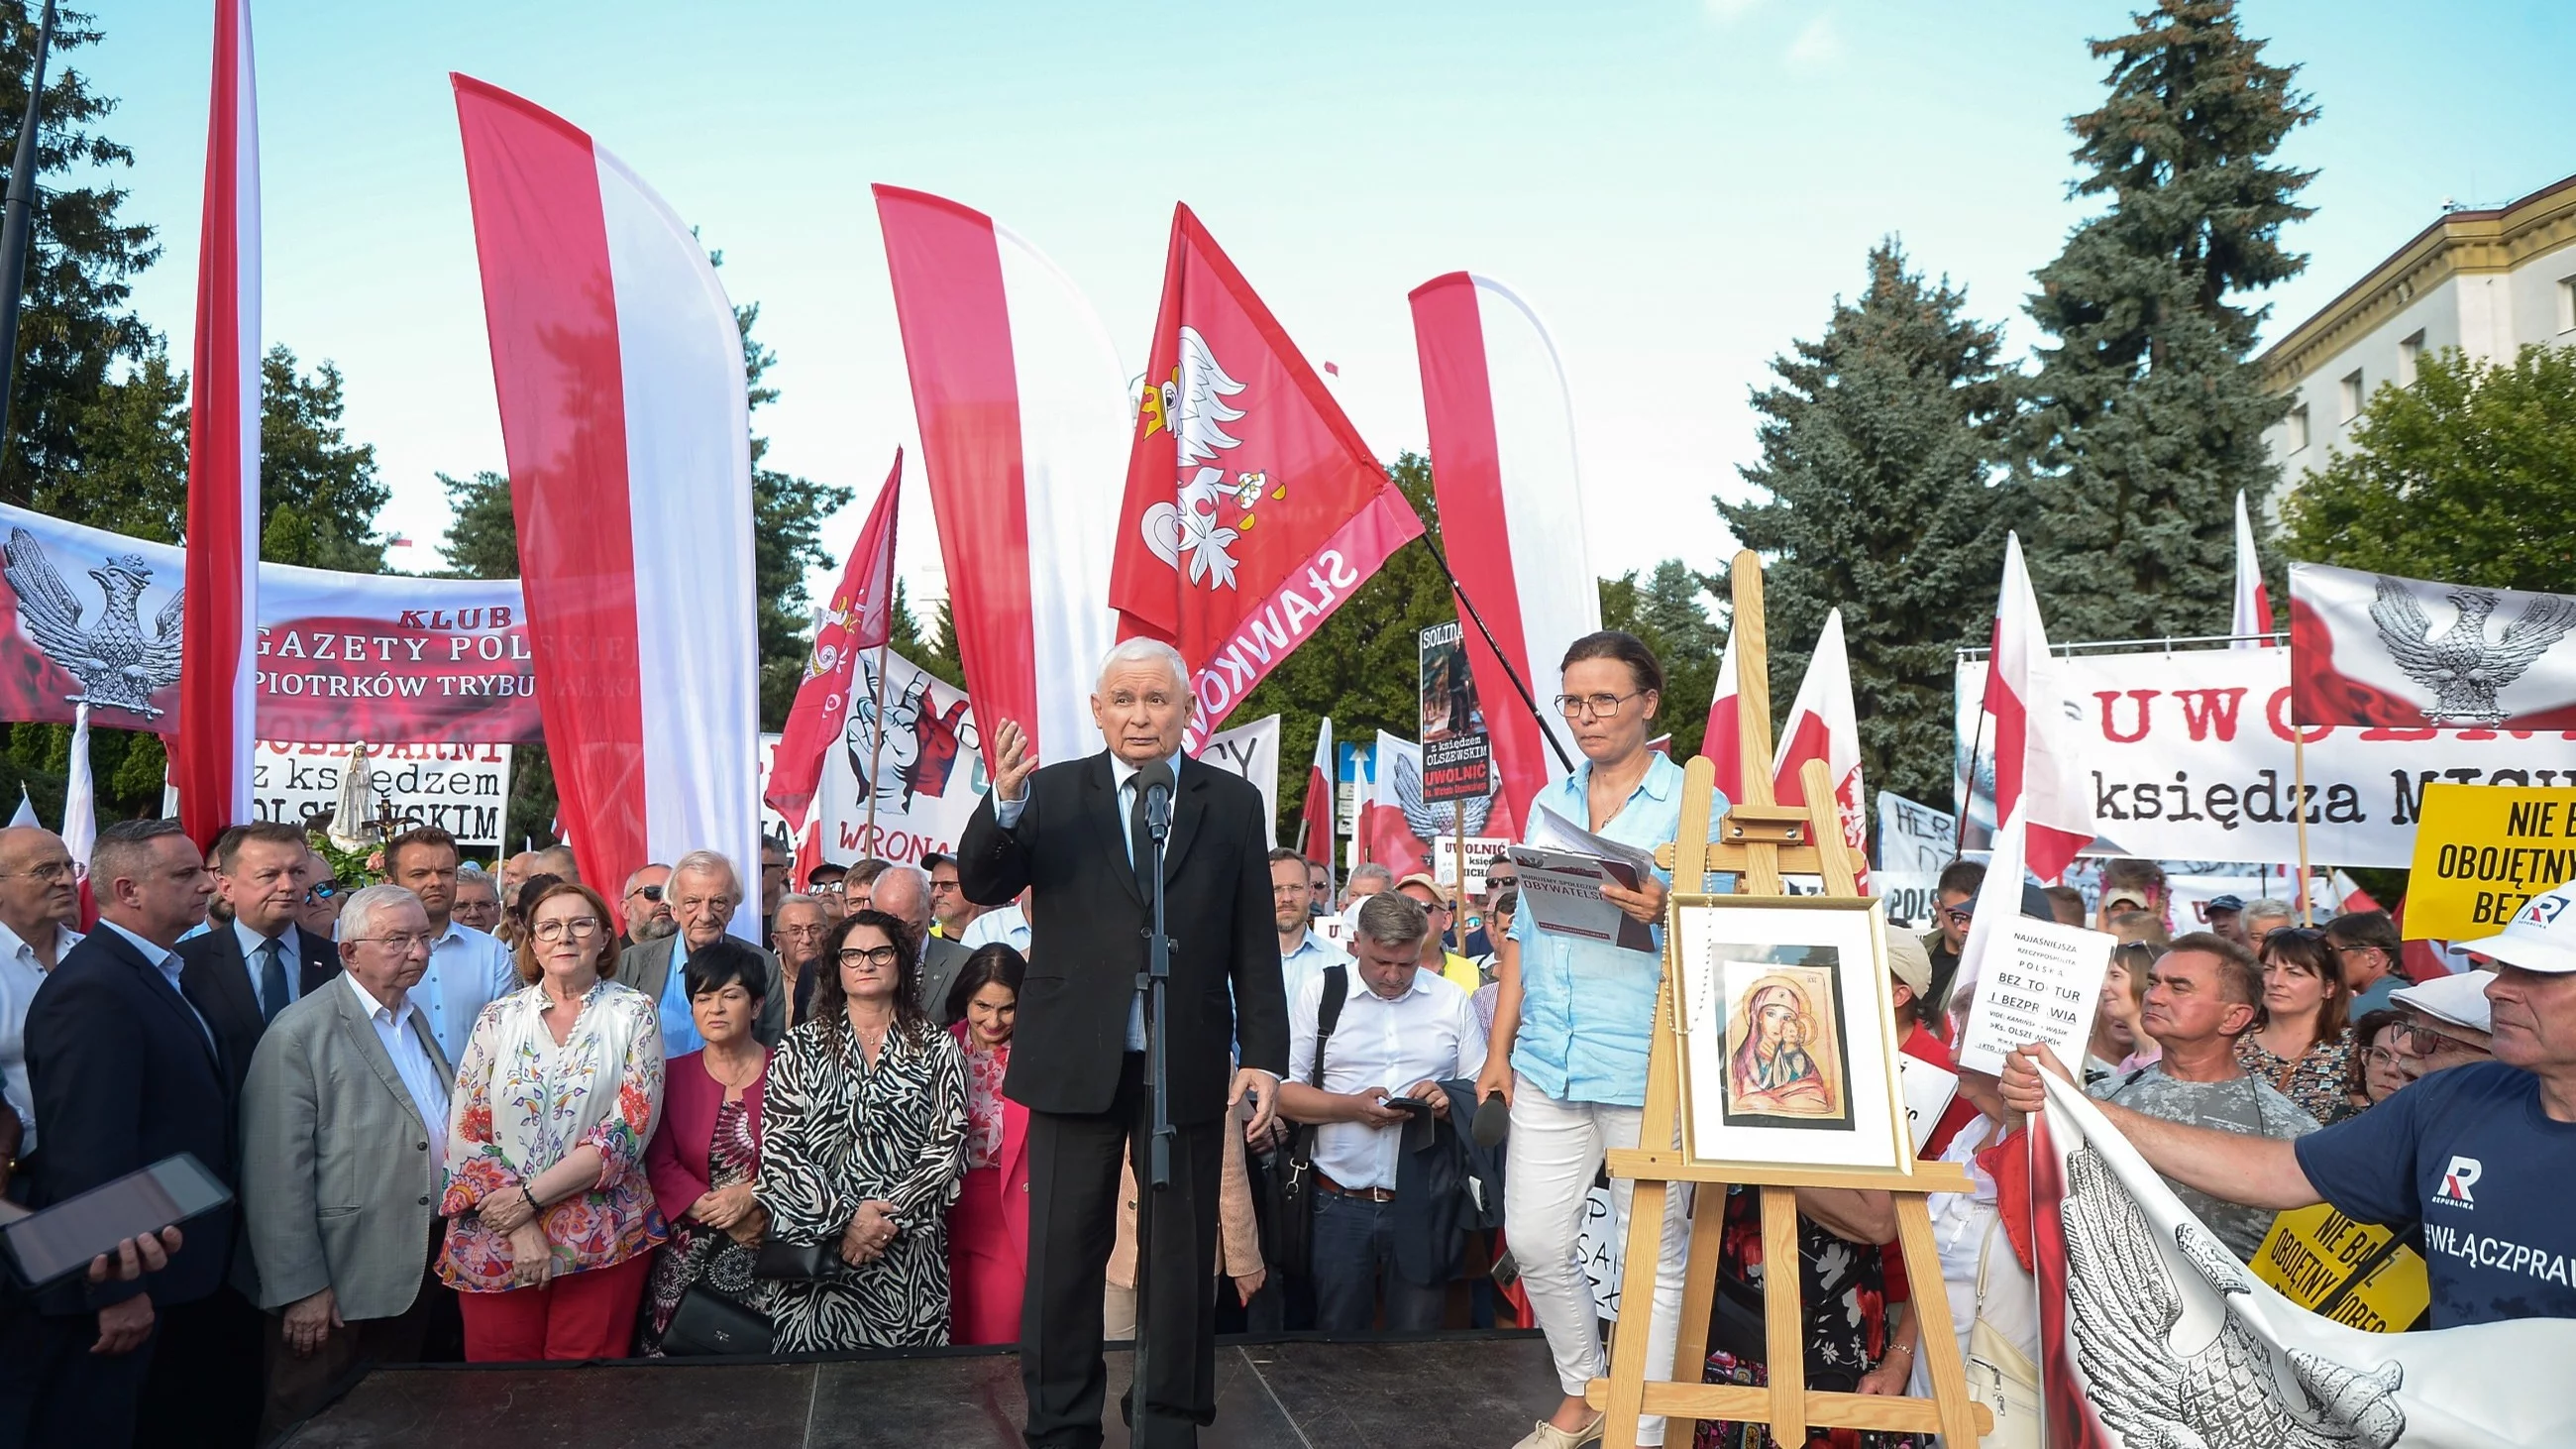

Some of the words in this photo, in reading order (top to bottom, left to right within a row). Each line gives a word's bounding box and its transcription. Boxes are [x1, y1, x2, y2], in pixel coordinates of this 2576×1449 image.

[398, 606, 512, 630] KLUB
[1427, 745, 1488, 767] OLSZEWSKIM
[285, 757, 501, 799] ksędzem
[1425, 761, 1486, 786] UWOLNIĆ
[2092, 769, 2365, 831] księdza
[2507, 802, 2558, 838] NIE
[1998, 971, 2022, 987] BEZ
[2431, 1195, 2474, 1210] REPUBLIKA
[2271, 1227, 2340, 1304] OBOJĘTNY
